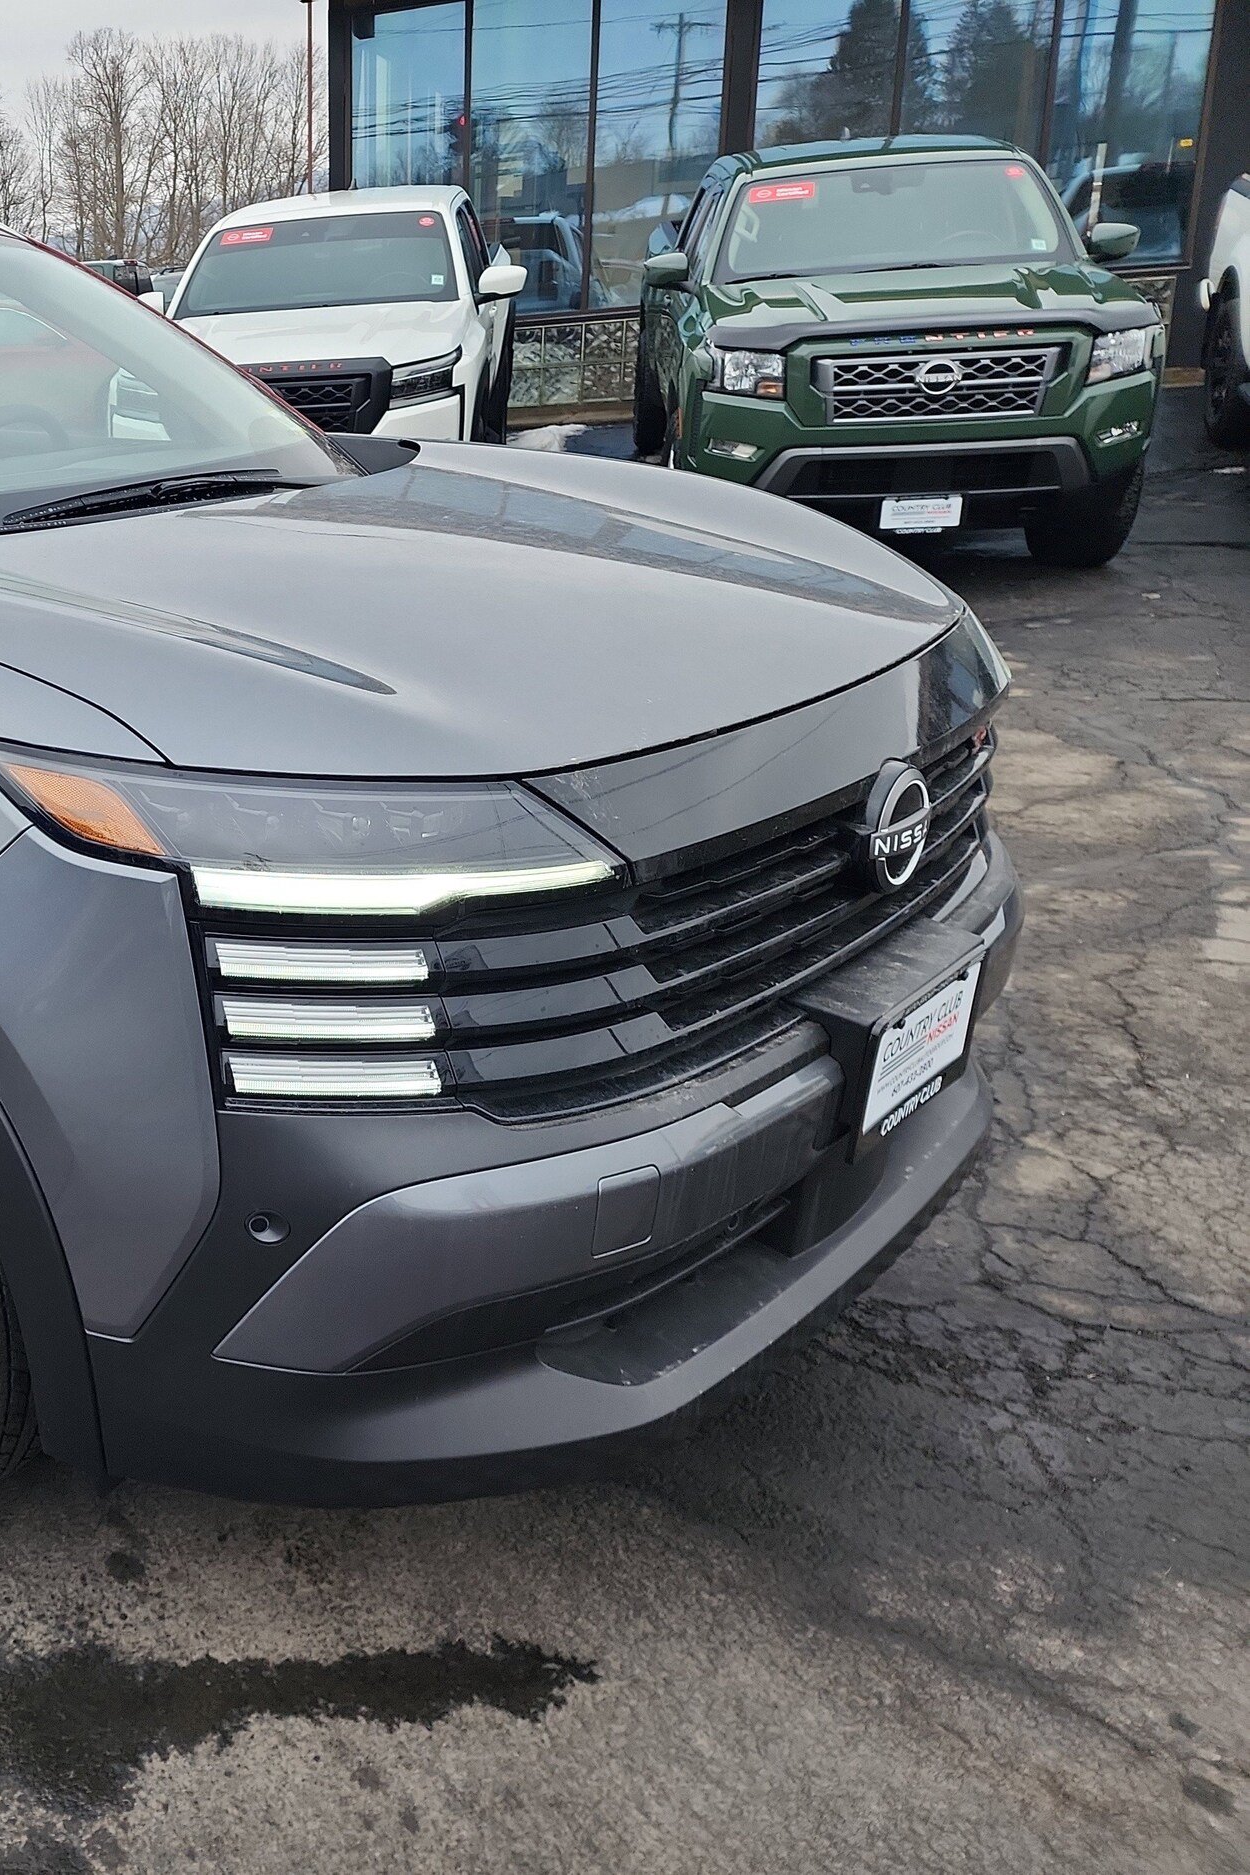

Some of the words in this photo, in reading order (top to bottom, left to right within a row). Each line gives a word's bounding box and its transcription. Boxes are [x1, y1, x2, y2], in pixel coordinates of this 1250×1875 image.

[883, 1012, 934, 1062] COUNTRY
[937, 990, 963, 1021] CLUB
[926, 1012, 959, 1044] NISSAN
[880, 1095, 920, 1136] COUNTRY
[920, 1075, 943, 1104] CLUB
